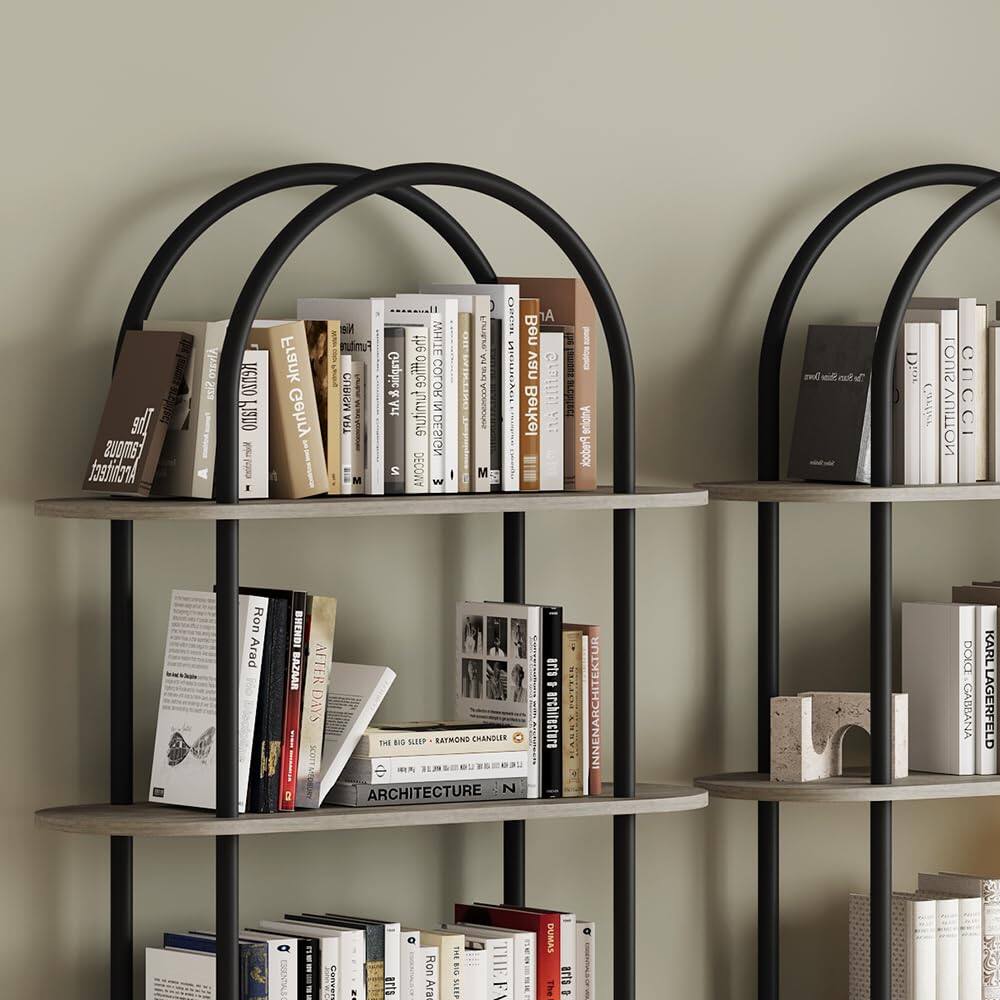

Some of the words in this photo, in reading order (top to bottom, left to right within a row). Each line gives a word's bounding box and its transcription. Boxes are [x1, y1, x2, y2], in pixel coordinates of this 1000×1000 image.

[252, 606, 264, 633] Ron
[293, 610, 303, 648] BHENDI
[248, 637, 260, 668] Arad
[313, 643, 327, 684] AFTER
[986, 630, 995, 666] KARL
[290, 651, 301, 690] BAZAAR
[547, 658, 559, 676] arts
[310, 689, 324, 722] DAYS
[592, 636, 600, 769] INNENARCHITEKTUR
[964, 683, 973, 739] GABBANA
[986, 669, 995, 749] LAGERFELD
[547, 692, 559, 748] architecture
[408, 738, 426, 746] SLEEP
[435, 736, 470, 744] RAYMOND
[472, 734, 508, 743] CHANDLER
[368, 784, 482, 801] ARCHITECTURE
[426, 956, 436, 977] Ron
[493, 942, 508, 977] THE
[562, 967, 573, 985] arts
[385, 977, 397, 995] arts
[547, 981, 555, 995] The
